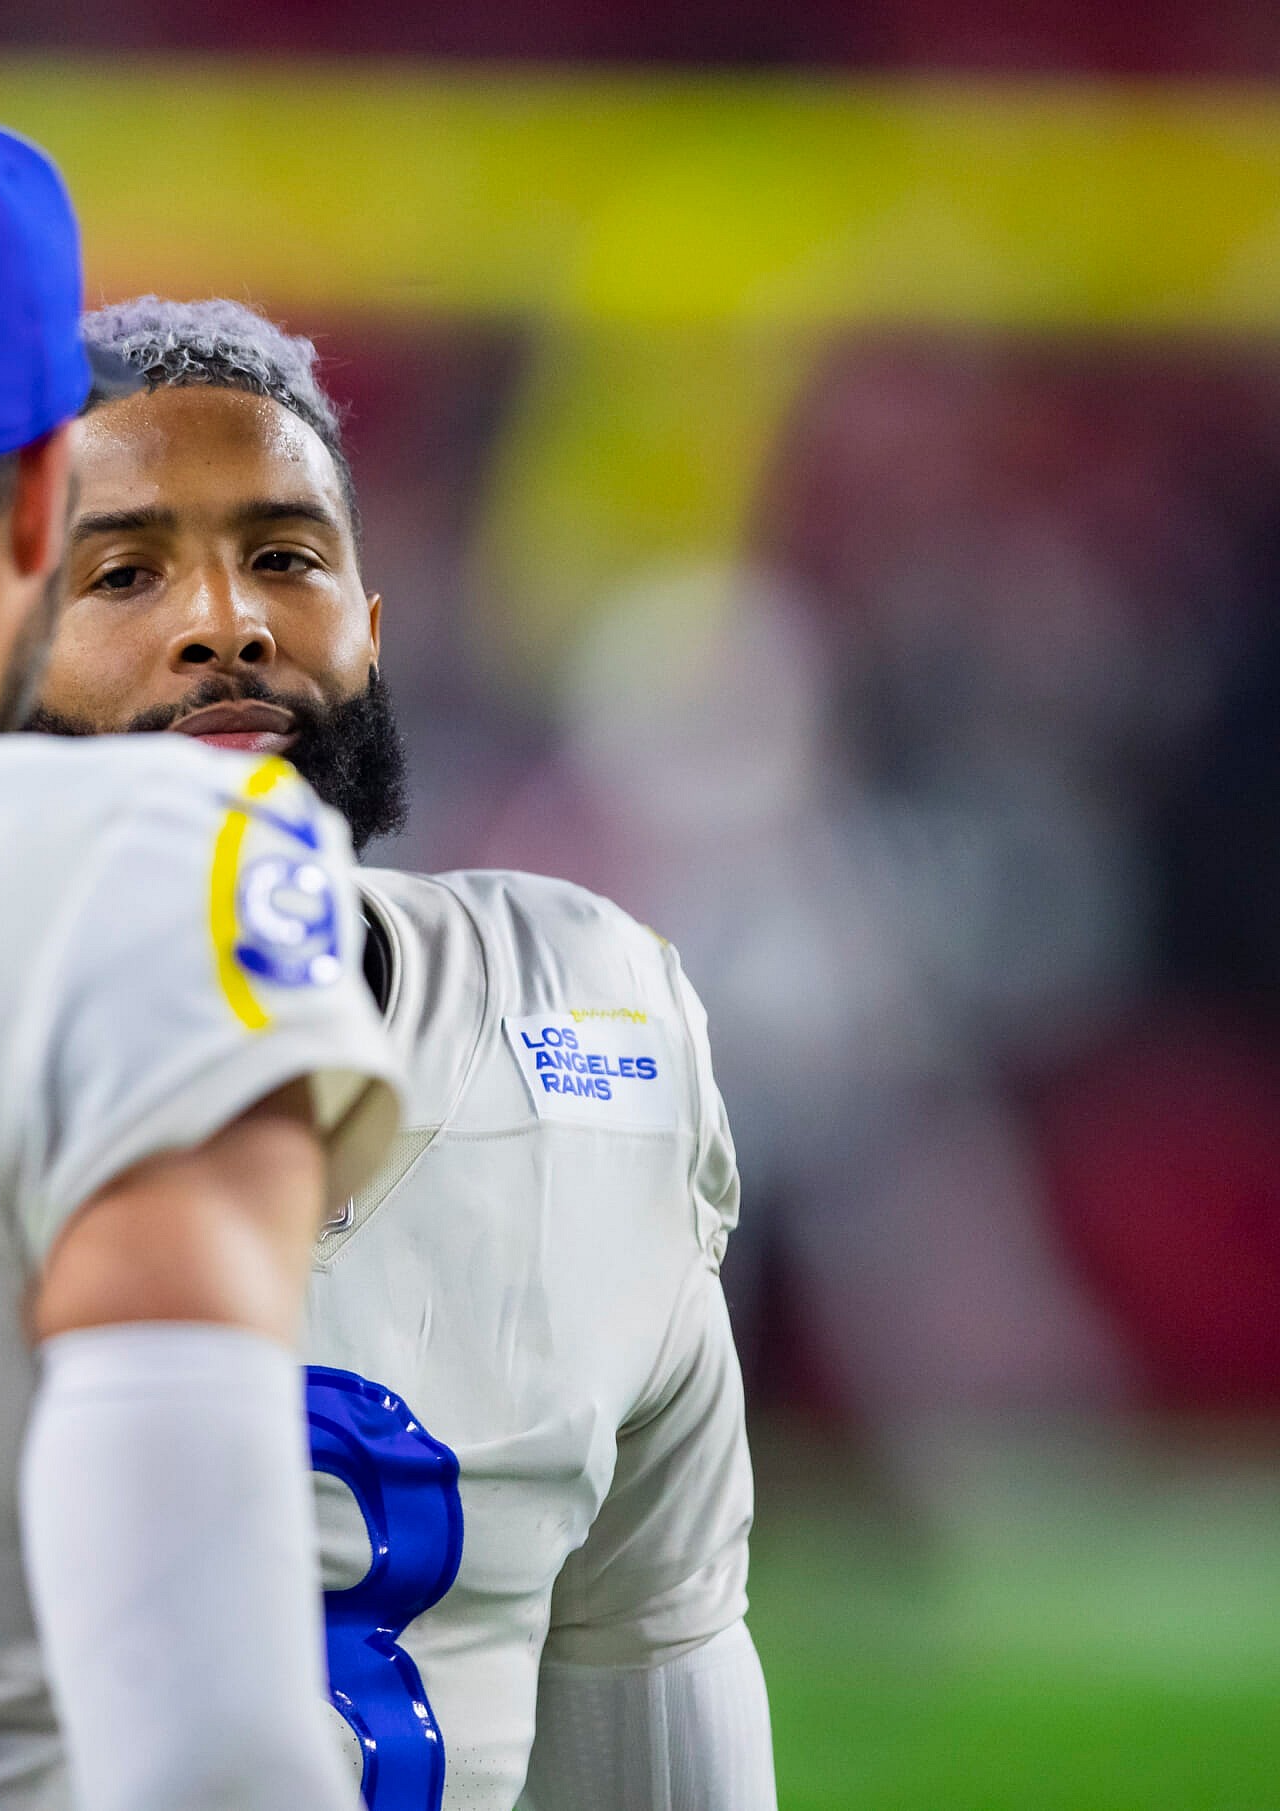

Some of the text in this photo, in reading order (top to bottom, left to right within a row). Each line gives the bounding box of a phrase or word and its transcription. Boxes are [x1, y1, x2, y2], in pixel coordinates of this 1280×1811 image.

[520, 1027, 579, 1050] LOS
[535, 1051, 658, 1080] ANGELES
[539, 1073, 613, 1101] RAMS
